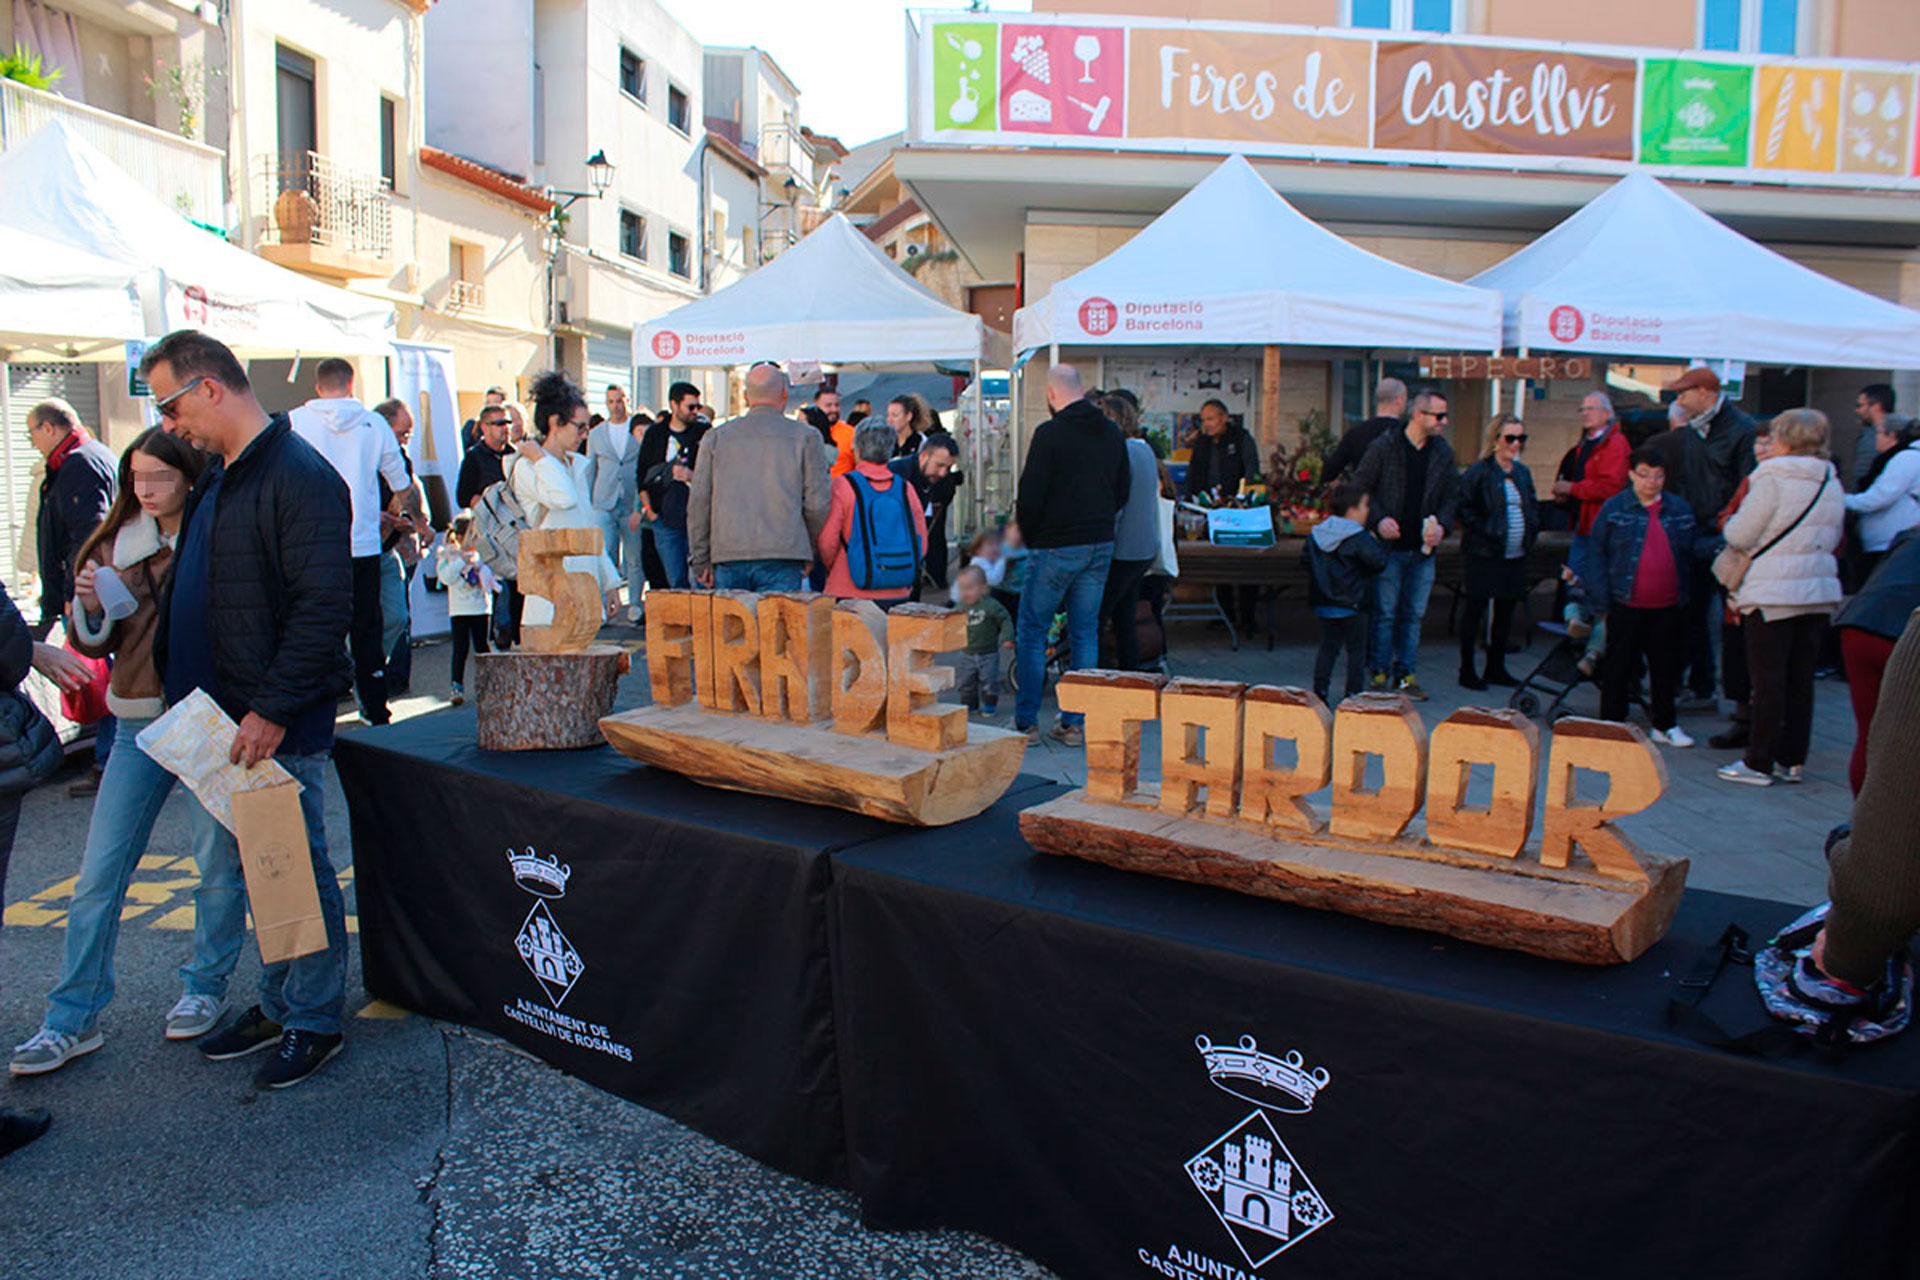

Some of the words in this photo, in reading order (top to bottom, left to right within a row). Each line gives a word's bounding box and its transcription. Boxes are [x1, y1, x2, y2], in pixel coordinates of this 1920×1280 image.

[1159, 44, 1278, 121] Fires
[1292, 51, 1355, 120] de
[1402, 60, 1616, 136] Castellví
[1125, 301, 1204, 317] Diputació
[1125, 317, 1203, 331] Barcelona
[686, 332, 745, 345] Diputació
[686, 345, 745, 356] Barcelona
[645, 588, 836, 724] FIRA
[830, 600, 968, 751] DE
[1056, 668, 1670, 884] TARDOR
[517, 998, 587, 1034] AJUNTAMENT
[589, 1023, 611, 1039] DE
[557, 1027, 574, 1044] DE
[574, 1033, 633, 1062] ROSANES
